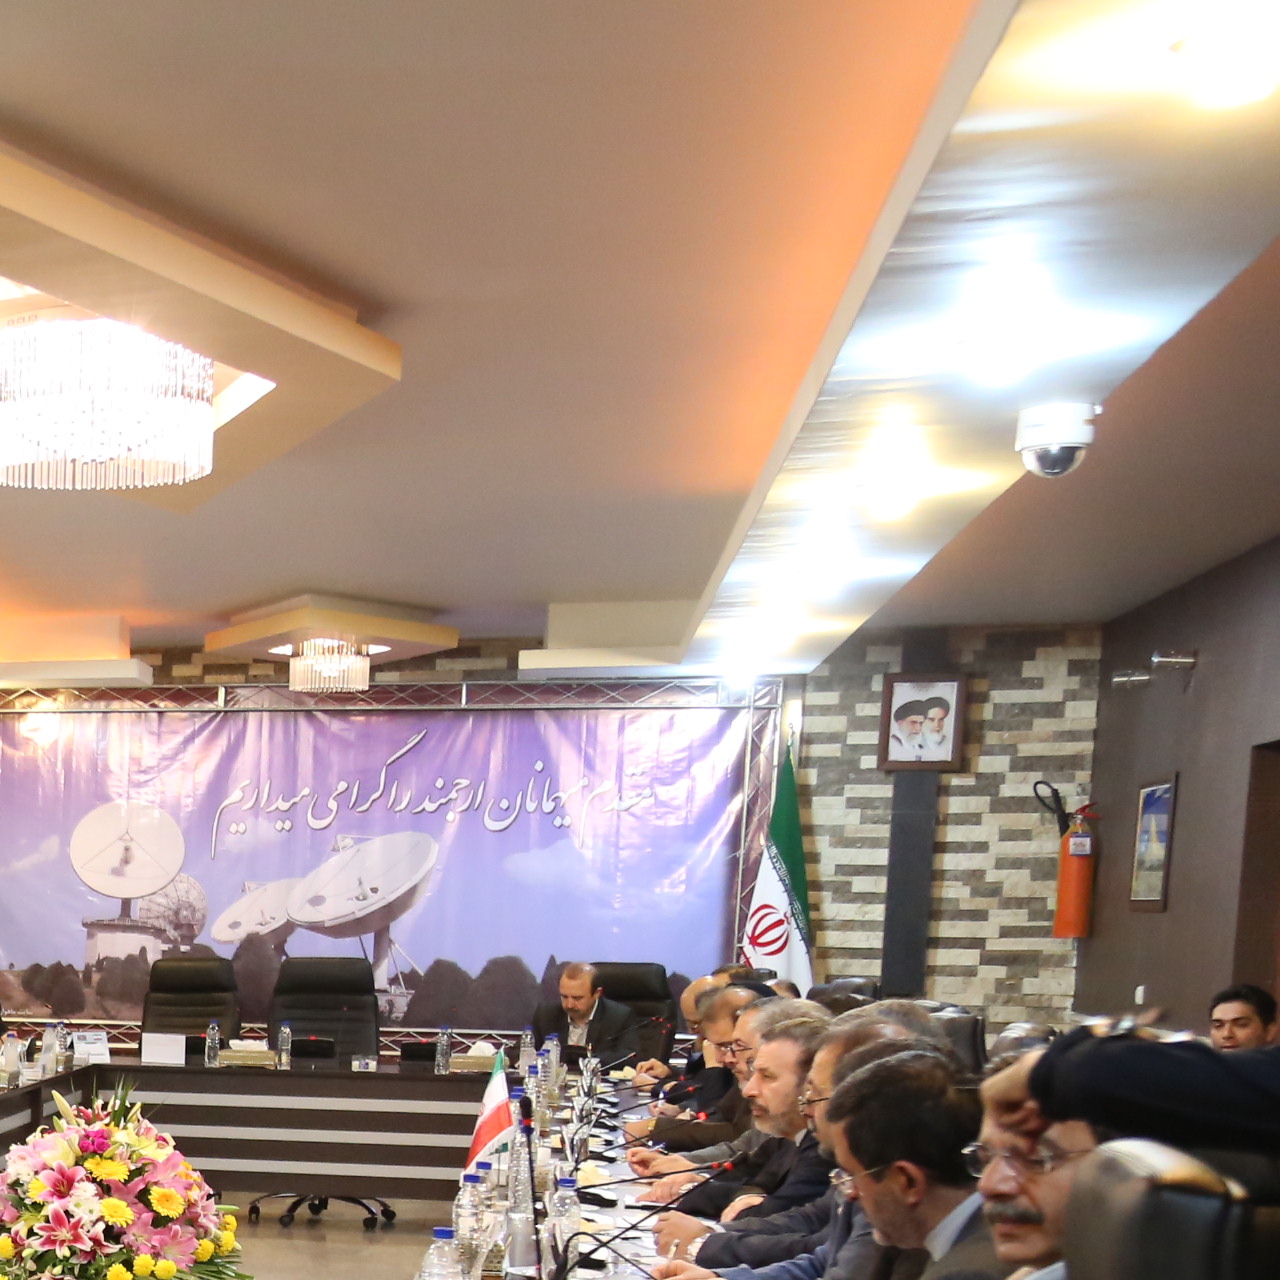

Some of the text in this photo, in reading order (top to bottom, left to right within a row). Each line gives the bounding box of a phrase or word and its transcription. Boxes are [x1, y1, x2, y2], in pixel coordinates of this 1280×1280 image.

[307, 729, 428, 830] گرامی
[386, 779, 412, 812] را
[412, 777, 485, 823] ارجمند
